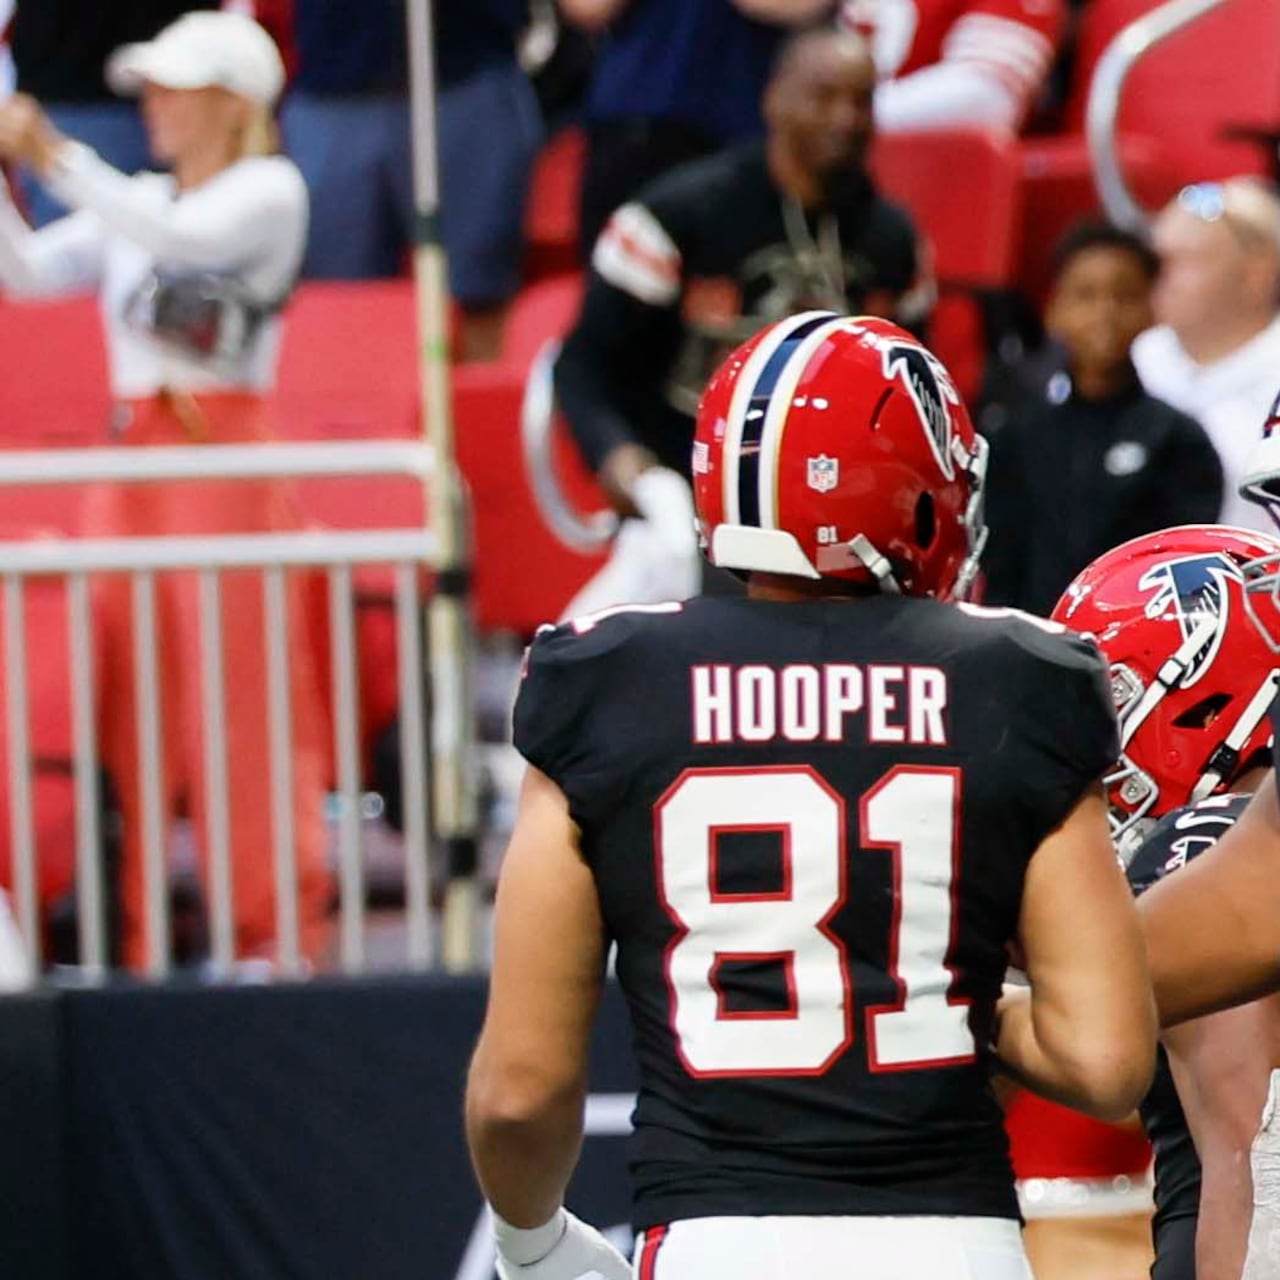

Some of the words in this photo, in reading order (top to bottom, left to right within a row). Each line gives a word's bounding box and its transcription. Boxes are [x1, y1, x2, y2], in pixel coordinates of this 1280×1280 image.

[817, 525, 839, 543] 81
[691, 664, 948, 745] HOOPER
[653, 764, 976, 1079] 81
